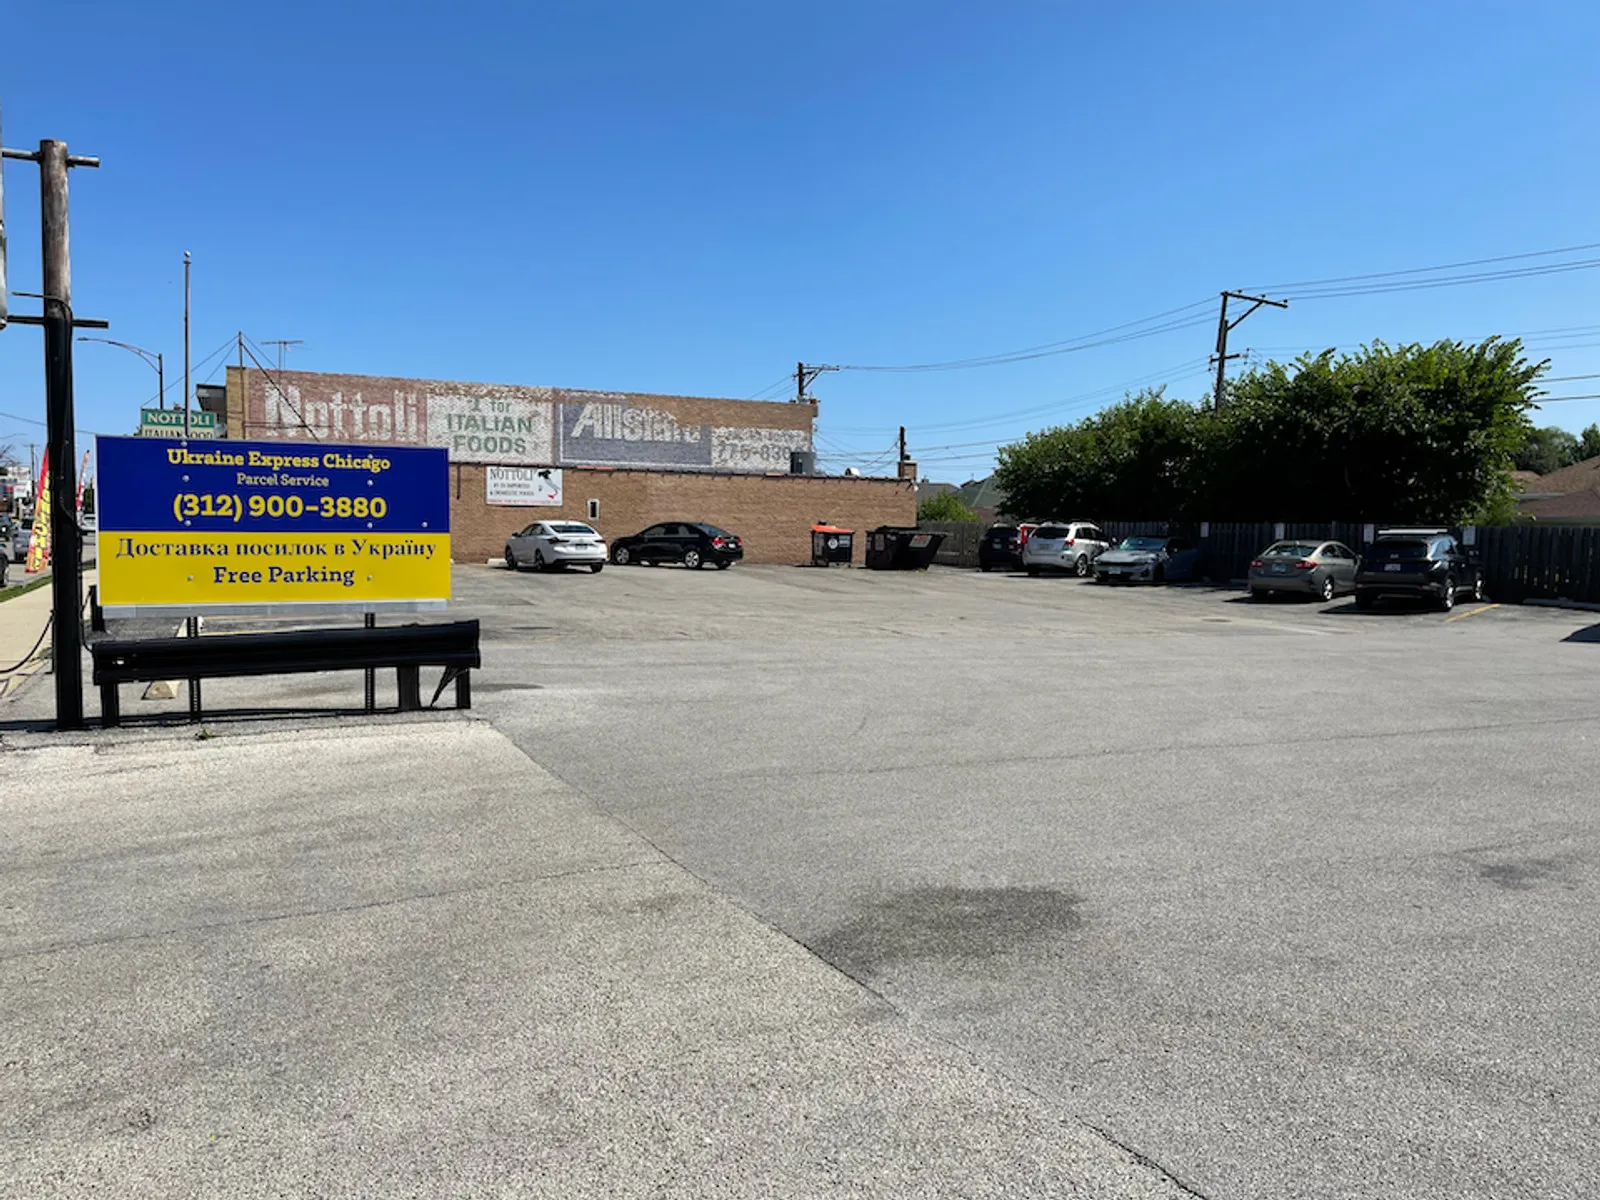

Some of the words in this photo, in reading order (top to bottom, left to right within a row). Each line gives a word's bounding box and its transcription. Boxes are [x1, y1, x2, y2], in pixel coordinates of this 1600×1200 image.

[447, 414, 533, 433] ITALIAN
[453, 435, 527, 454] FOODS
[167, 449, 245, 465] Ukraine
[248, 451, 320, 471] Express
[323, 453, 392, 473] Chicago
[236, 472, 278, 486] Parcel
[280, 474, 330, 487] Service
[173, 493, 243, 523] (312)
[248, 495, 387, 518] 900-3880
[116, 538, 229, 559] Доставка
[236, 543, 328, 556] посилок
[334, 543, 345, 556] в
[351, 539, 436, 560] Україну
[213, 566, 263, 583] Free
[268, 565, 355, 587] Parking
